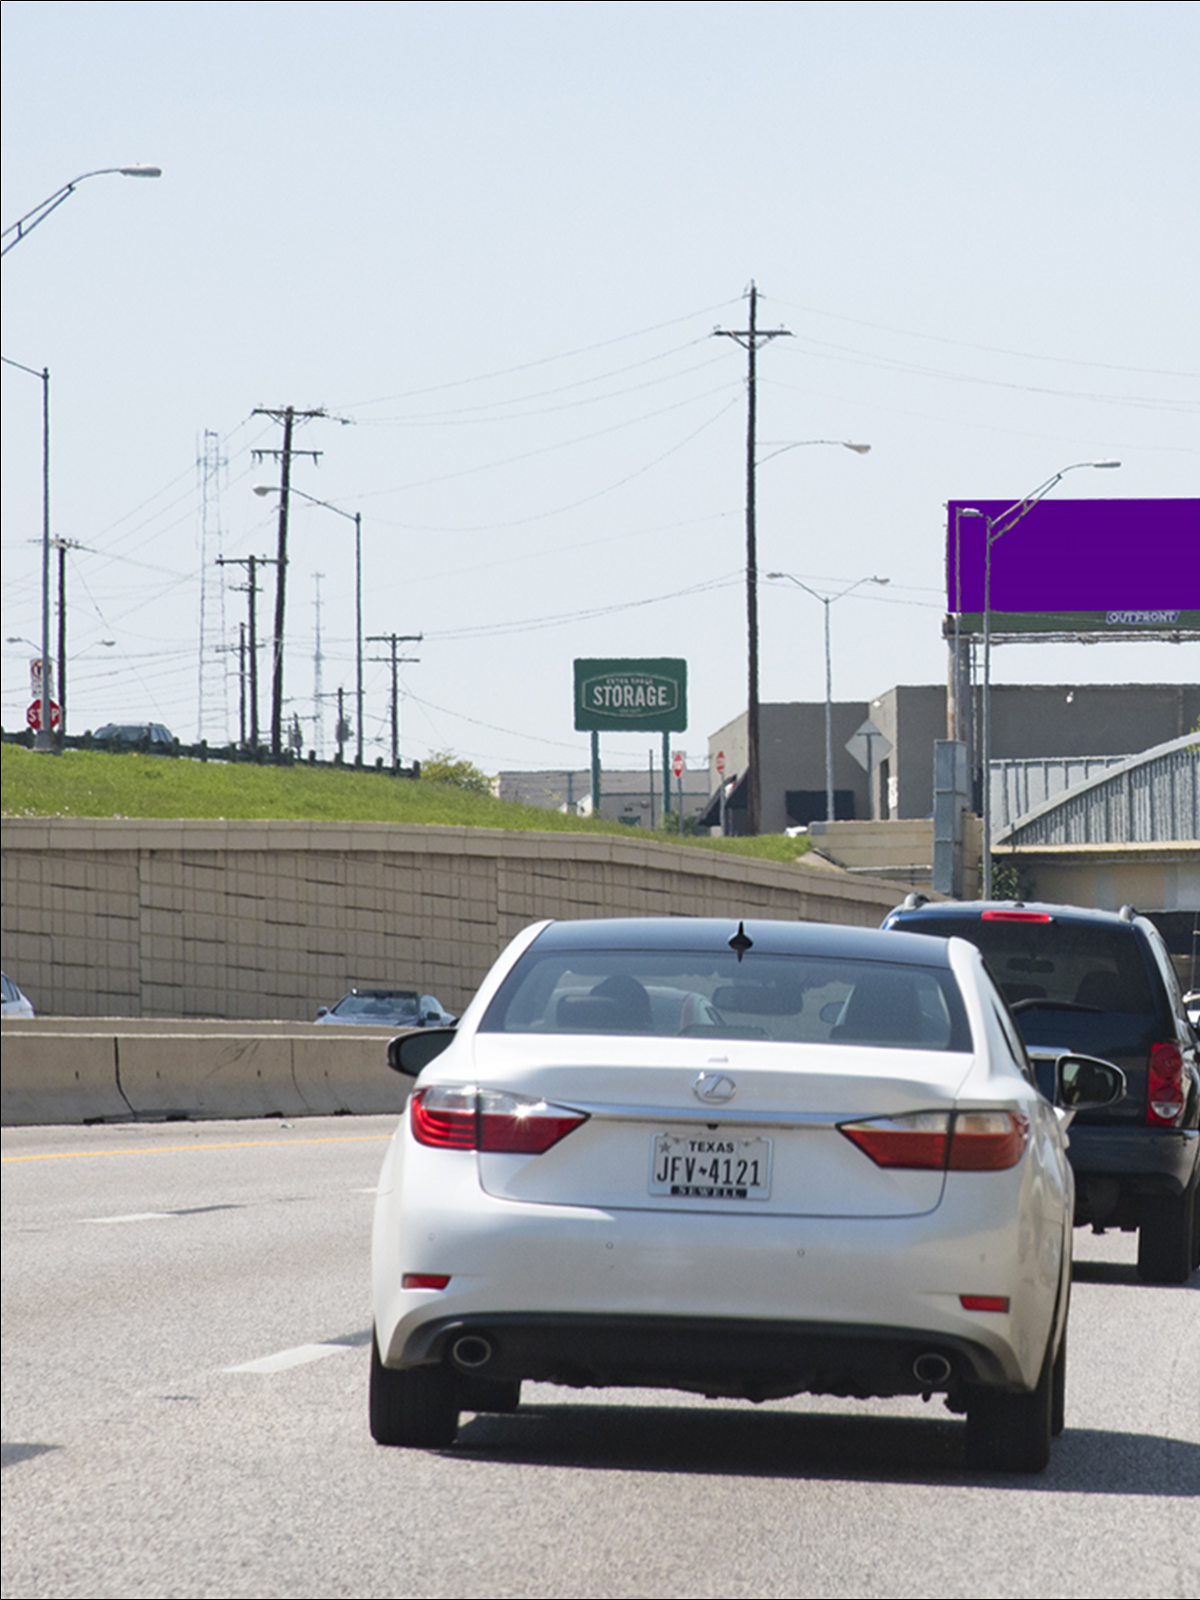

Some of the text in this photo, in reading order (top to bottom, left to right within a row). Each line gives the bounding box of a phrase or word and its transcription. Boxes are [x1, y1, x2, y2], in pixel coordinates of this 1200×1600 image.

[1107, 611, 1180, 623] OUTFRONT
[593, 685, 667, 707] STORAGE
[28, 708, 59, 722] STP
[689, 1141, 734, 1153] TEXAS
